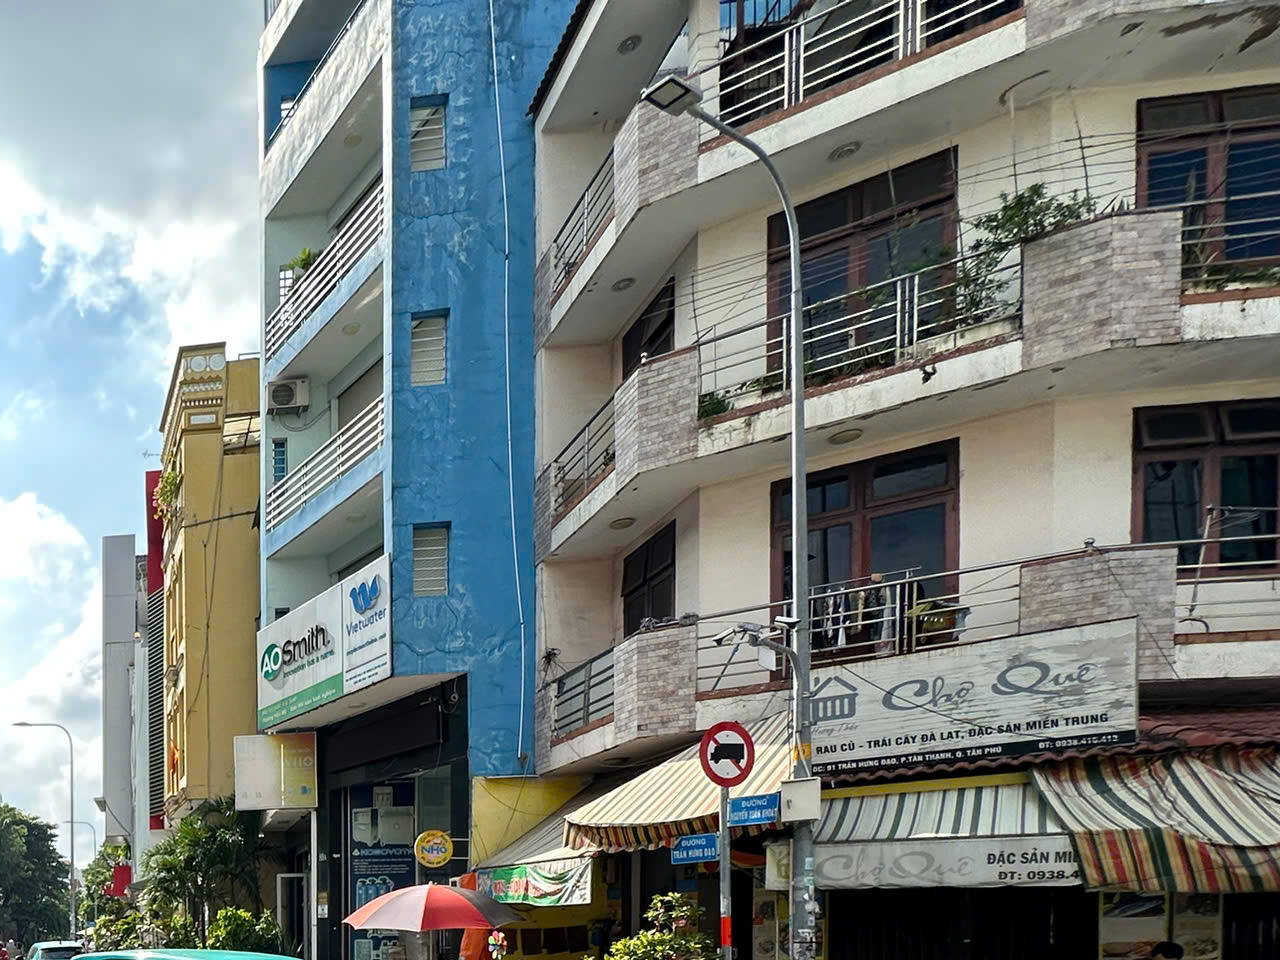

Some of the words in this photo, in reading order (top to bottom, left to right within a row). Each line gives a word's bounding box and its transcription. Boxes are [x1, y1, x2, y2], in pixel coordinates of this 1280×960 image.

[346, 608, 387, 637] Vietwater
[992, 661, 1097, 698] Quê
[816, 744, 837, 755] RAU
[840, 739, 855, 753] CỦ
[867, 737, 892, 749] TRÁI
[896, 733, 918, 747] CÂY
[921, 731, 937, 743] ĐÀ
[968, 724, 993, 739] ĐẶC
[997, 720, 1021, 734] SẢN
[1026, 717, 1059, 730] MIỀN
[1064, 713, 1109, 726] TRUNG
[741, 798, 768, 808] ĐƯỜNG
[681, 837, 706, 848] ĐƯỜNG
[986, 850, 1017, 868] ĐẶC
[1020, 847, 1050, 865] SẢN
[998, 871, 1022, 880] ĐT:
